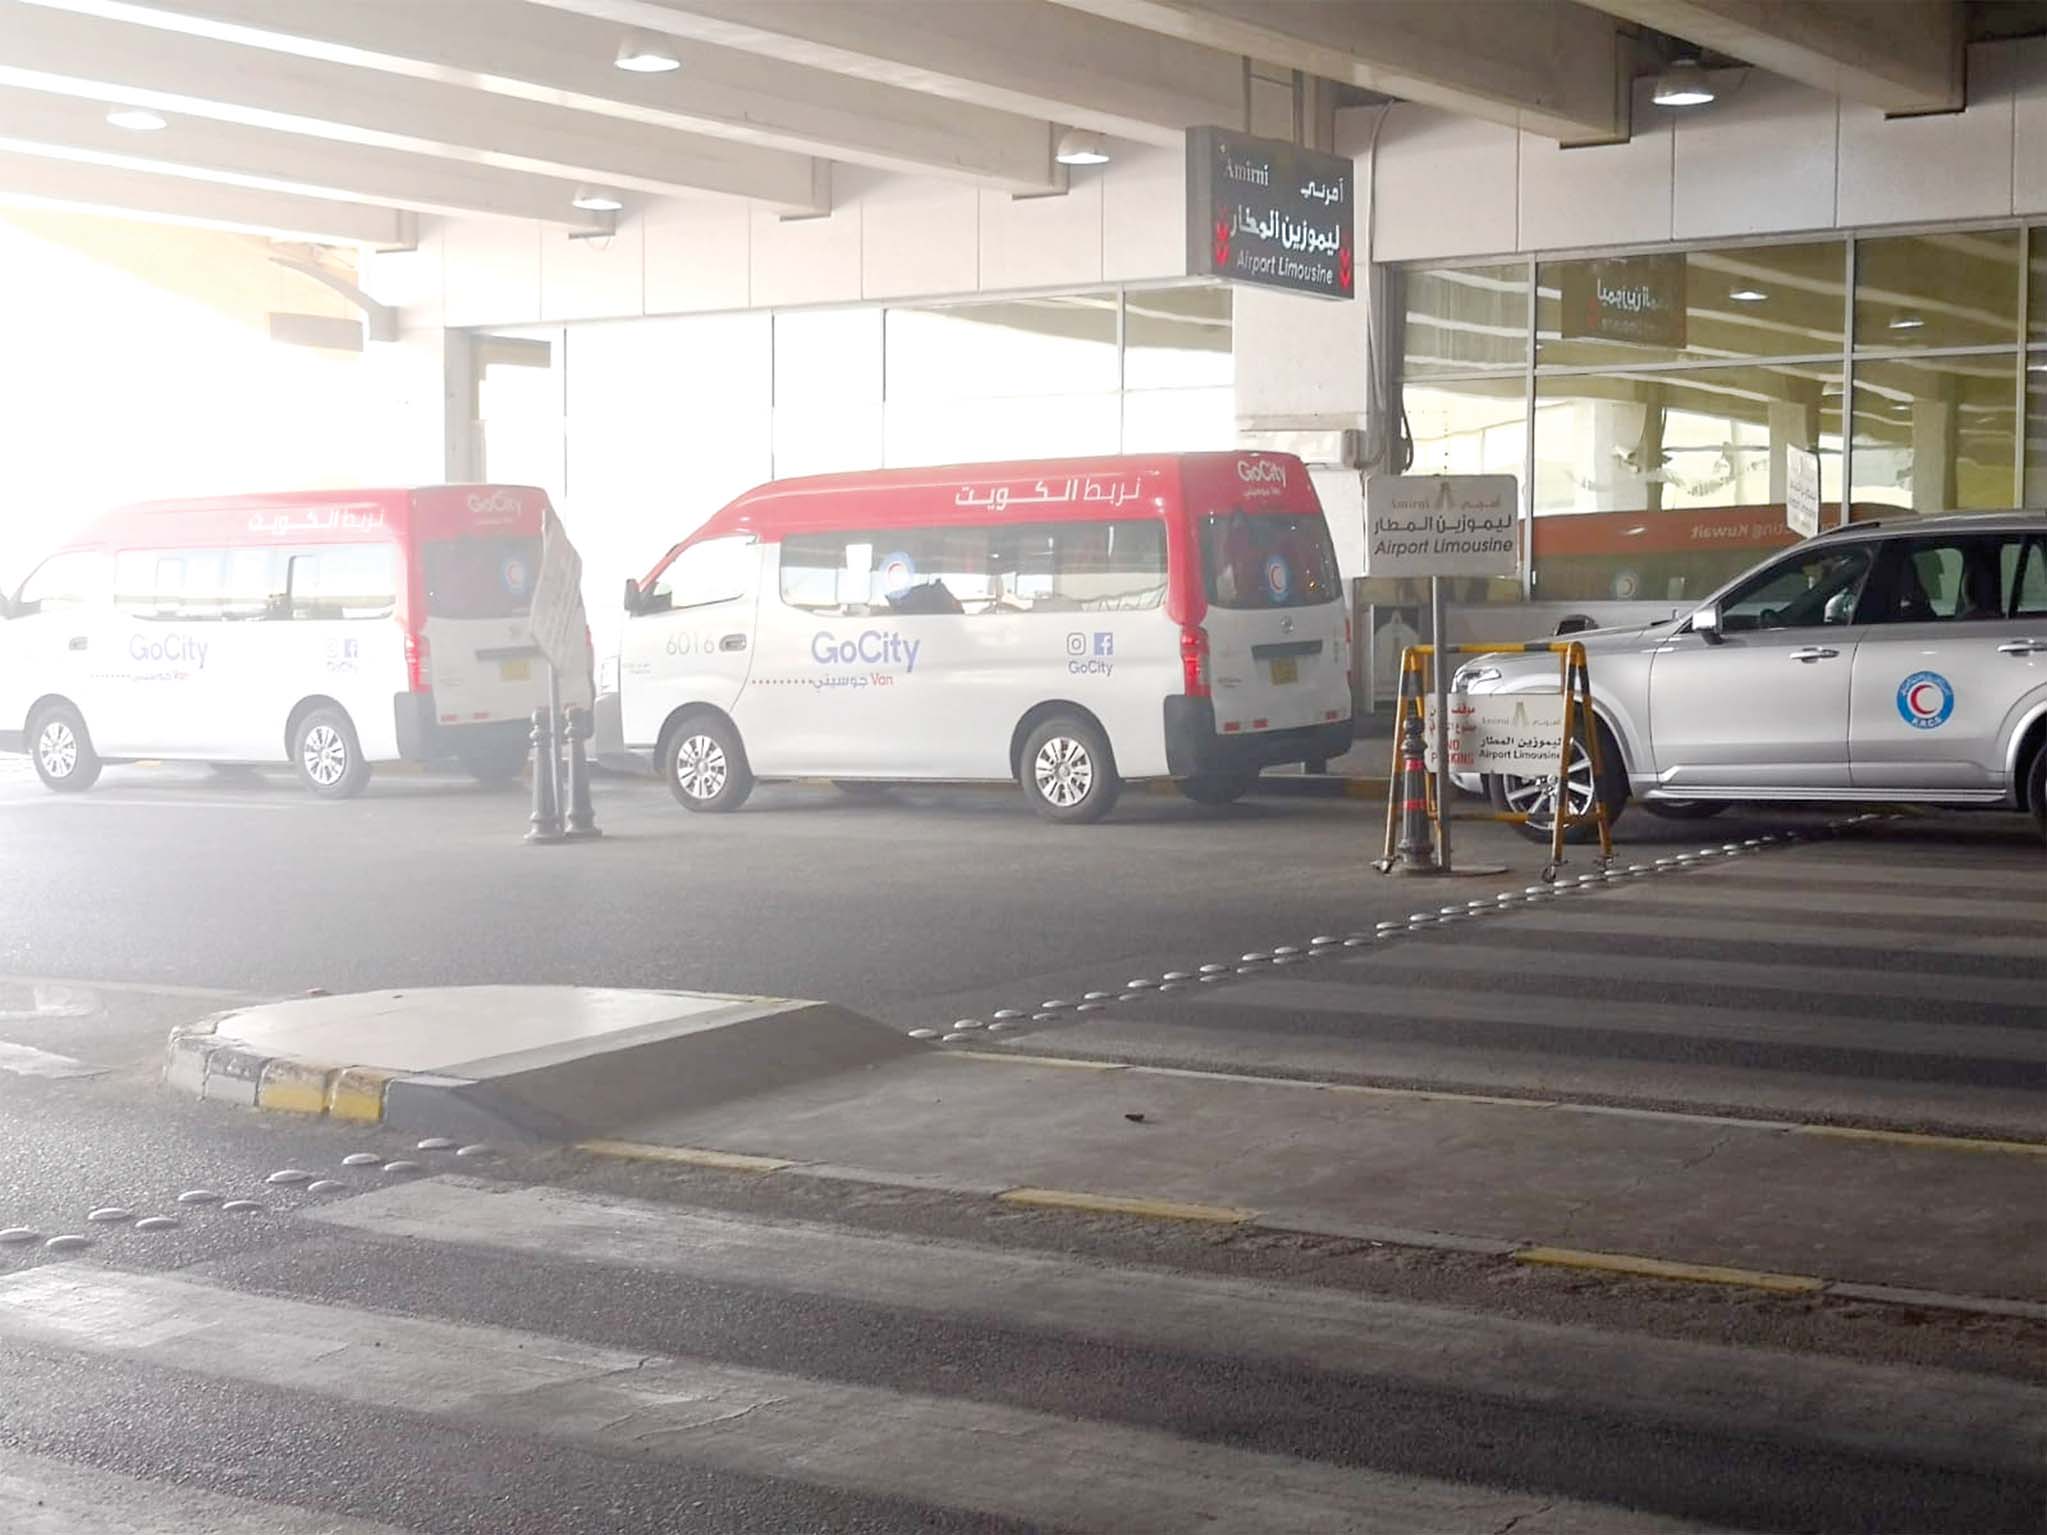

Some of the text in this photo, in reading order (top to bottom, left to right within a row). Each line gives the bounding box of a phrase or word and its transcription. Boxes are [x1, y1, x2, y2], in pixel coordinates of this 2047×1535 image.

[1229, 204, 1340, 256] ليموزين المطار
[1237, 251, 1334, 285] Airport Limousine
[1237, 460, 1287, 488] GoCity
[1083, 477, 1142, 507] نربط
[1374, 514, 1512, 535] ليموزين المطار
[1375, 537, 1513, 557] Airport Limousine
[811, 630, 920, 673] GoCity
[870, 672, 894, 685] Van
[1068, 660, 1114, 677] GoCity
[1479, 749, 1511, 761] Airport
